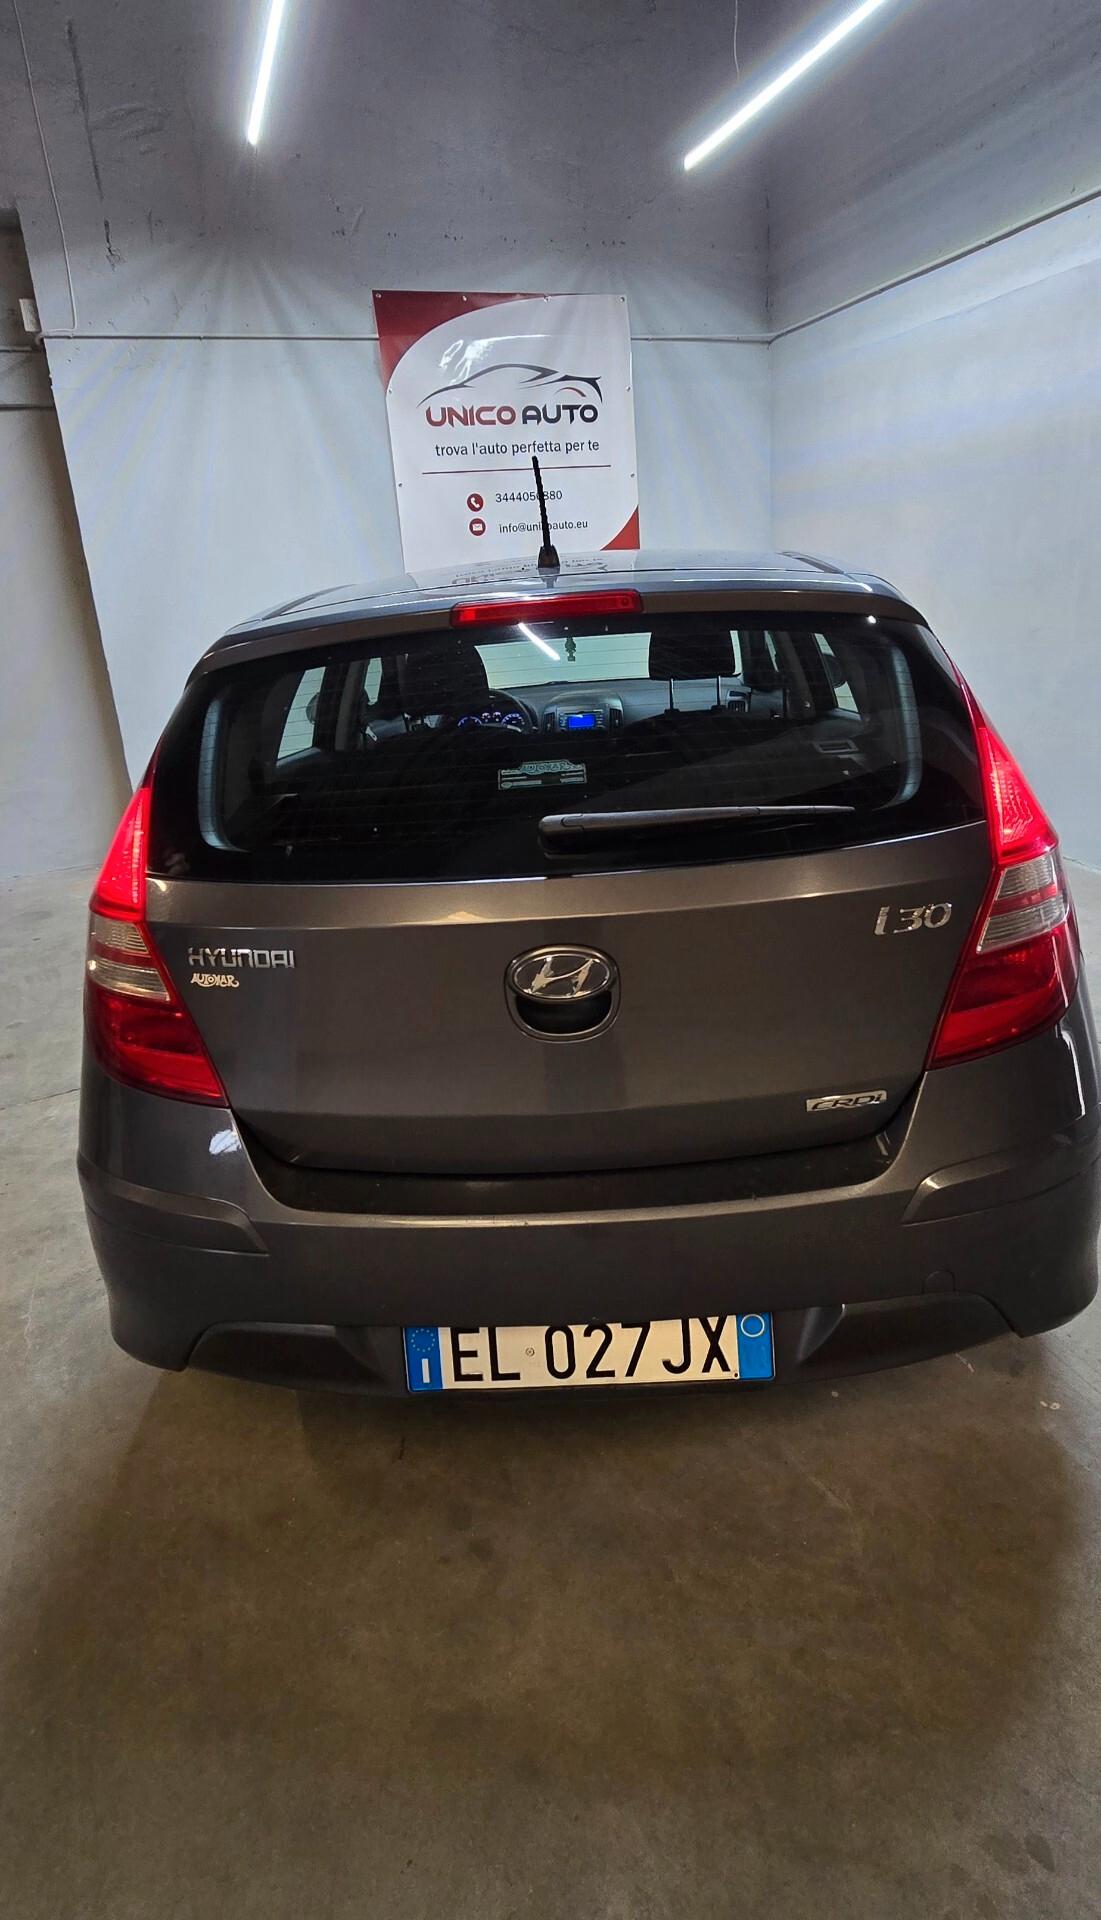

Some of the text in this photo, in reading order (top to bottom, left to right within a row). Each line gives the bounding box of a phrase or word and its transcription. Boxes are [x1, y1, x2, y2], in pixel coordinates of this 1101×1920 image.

[425, 404, 599, 428] UNICO AUTO
[435, 439, 600, 456] trova l'auto perfetta per te
[499, 521, 588, 533] info@unioauto.eu
[187, 947, 295, 968] HYUNDAI
[450, 1314, 731, 1382] EL 027 JX
